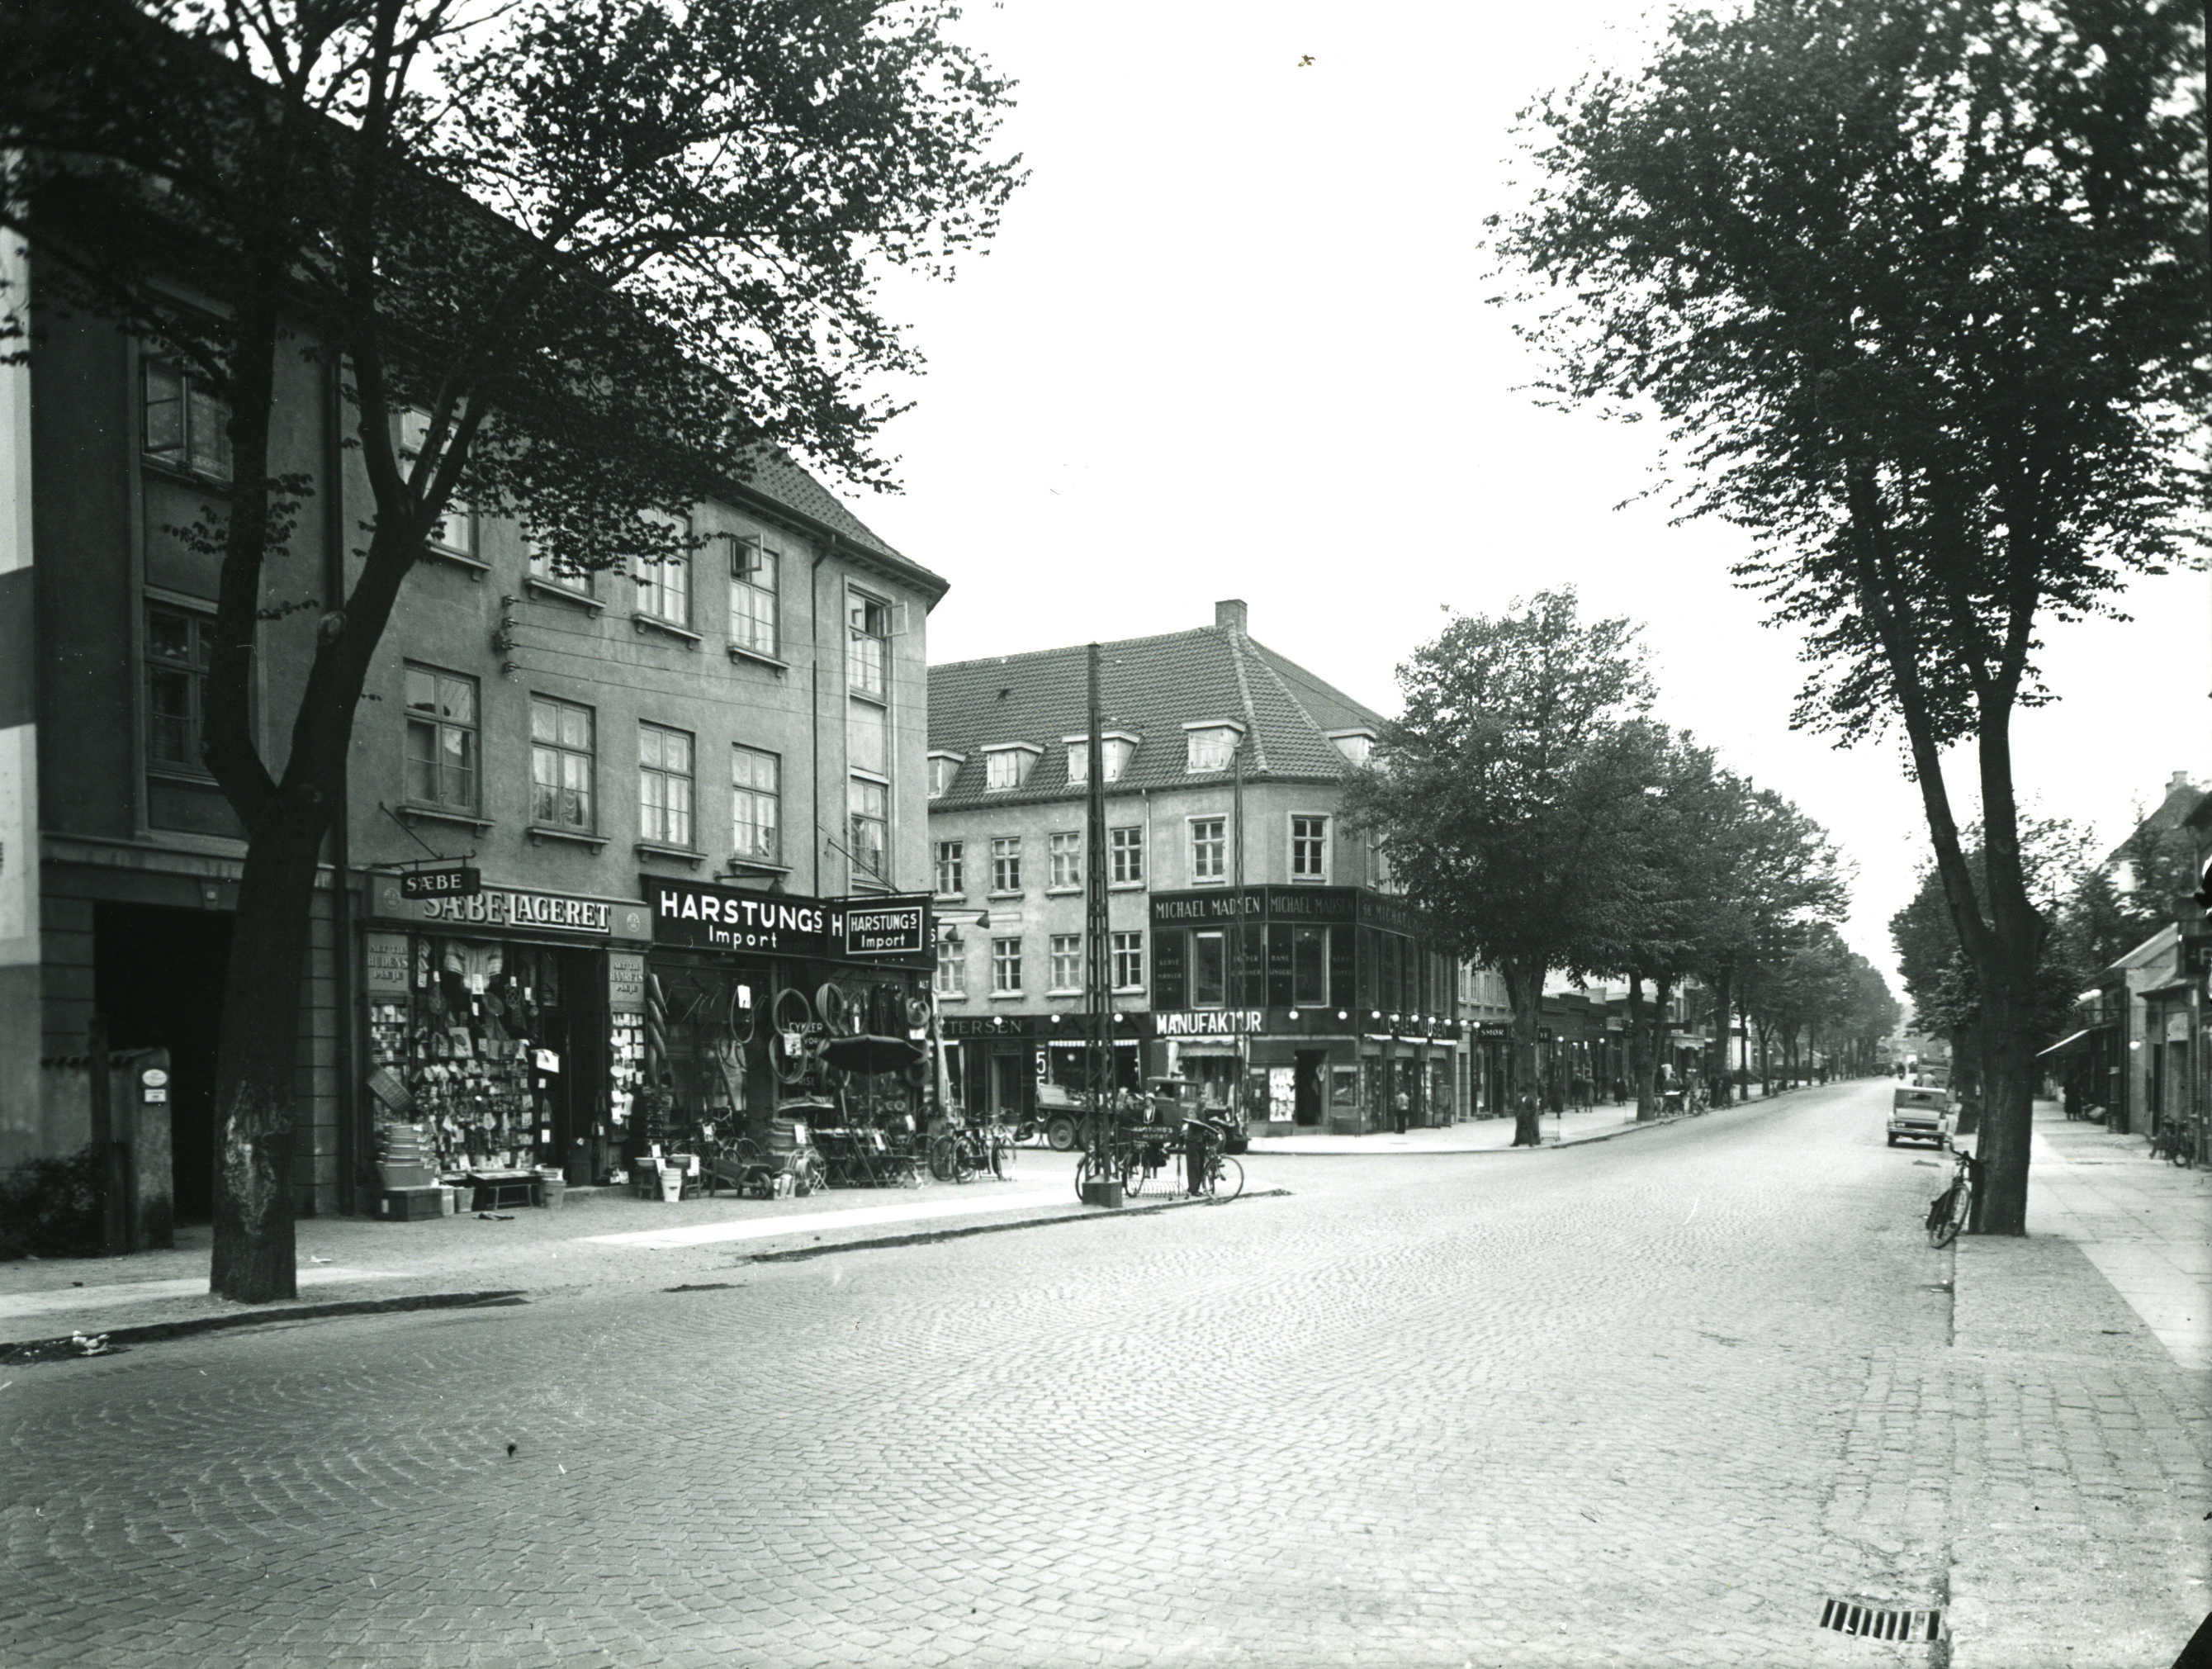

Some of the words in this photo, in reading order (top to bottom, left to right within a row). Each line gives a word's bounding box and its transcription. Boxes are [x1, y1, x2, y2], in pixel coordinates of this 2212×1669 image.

[406, 874, 462, 892] SÆBE
[1155, 899, 1206, 919] MICHAEL
[1211, 896, 1262, 916] MADSEN
[1269, 895, 1313, 914] MICHAEL
[708, 924, 779, 950] Import
[860, 933, 907, 950] Import
[1156, 1011, 1263, 1035] MANUFAKTUR
